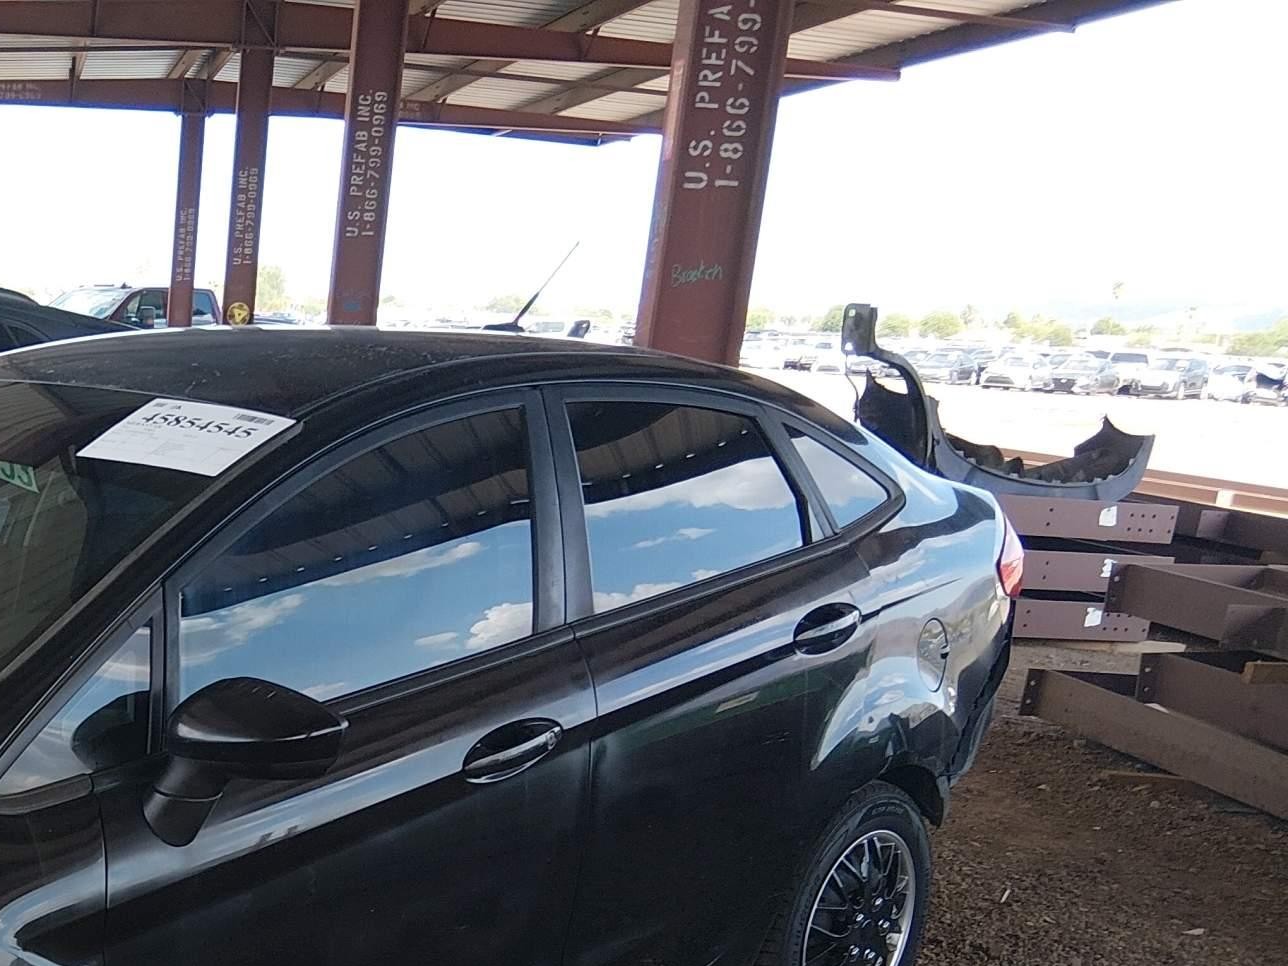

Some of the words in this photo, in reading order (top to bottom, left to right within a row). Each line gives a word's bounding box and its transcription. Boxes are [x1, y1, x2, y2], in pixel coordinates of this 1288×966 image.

[357, 89, 374, 122] INC.
[350, 130, 368, 196] PREFAB
[362, 91, 388, 236] 1-866-799-0969
[683, 130, 716, 190] U.S.
[345, 206, 362, 237] U.S.
[142, 412, 259, 439] 45854545
